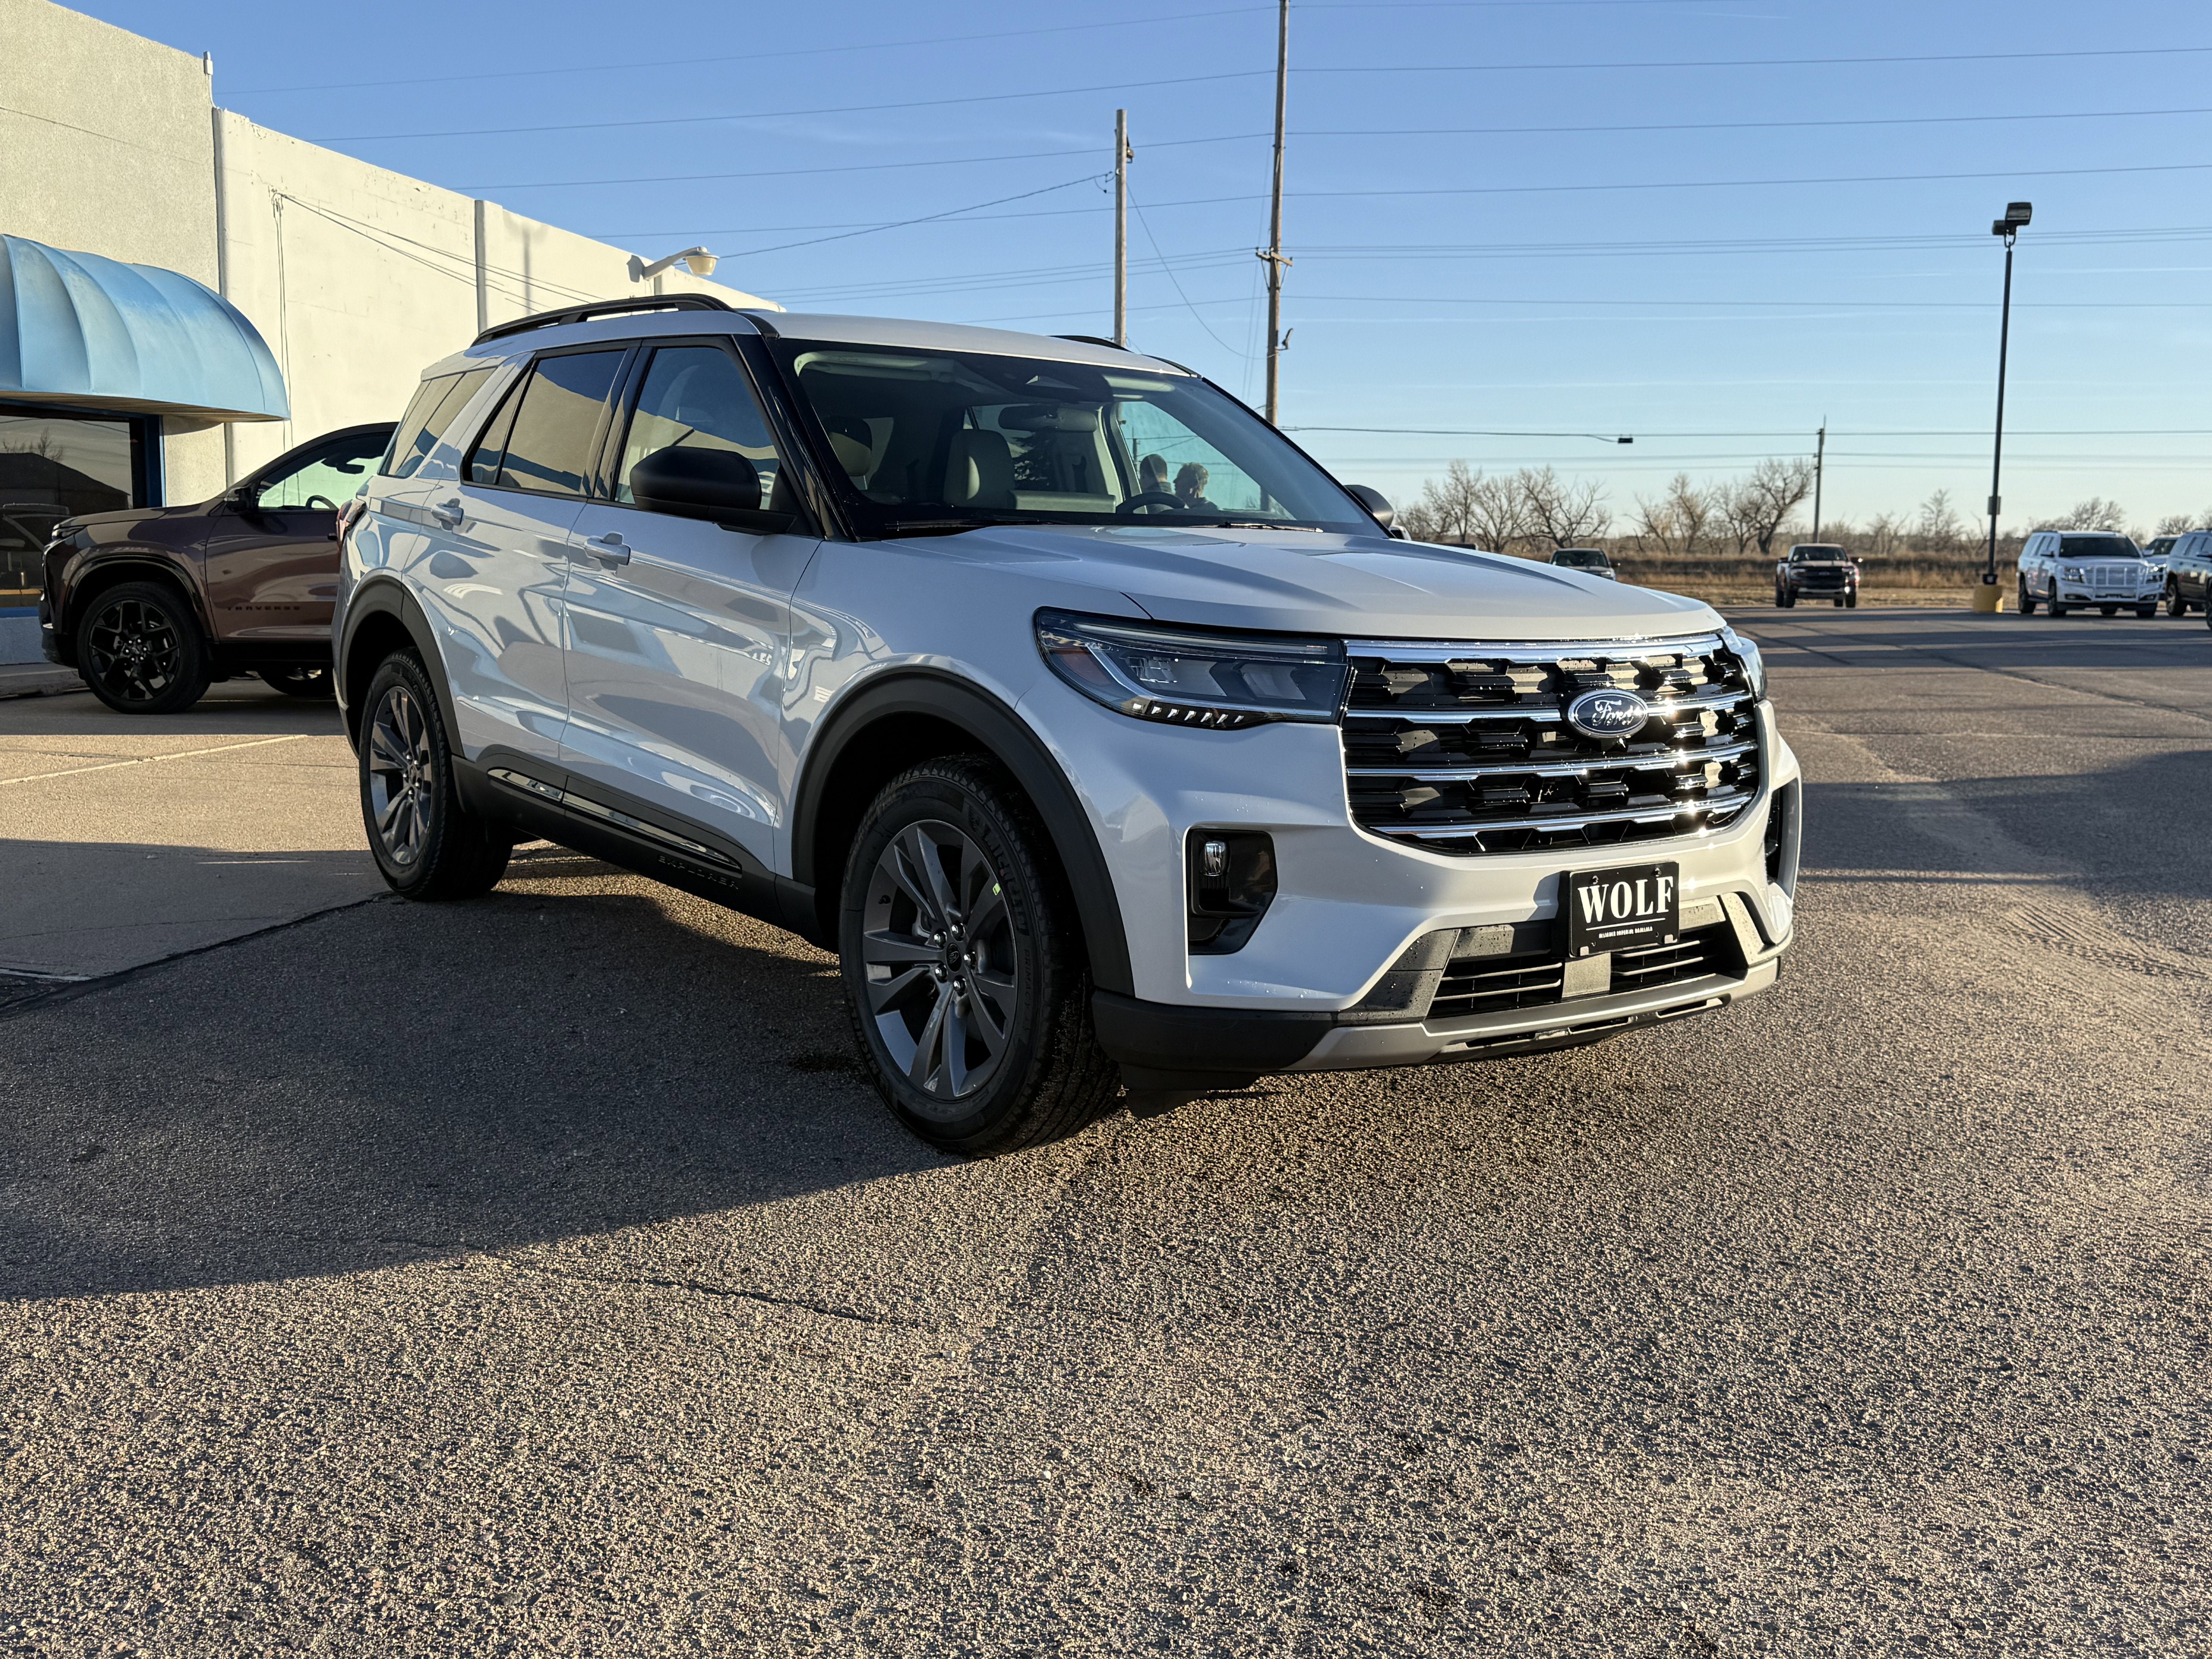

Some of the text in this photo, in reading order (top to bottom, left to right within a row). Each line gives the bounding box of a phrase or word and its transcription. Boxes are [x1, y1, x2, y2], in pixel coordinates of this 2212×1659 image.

[1592, 699, 1634, 726] Ford
[658, 855, 739, 890] EXPLORER
[1577, 876, 1674, 923] WOLF
